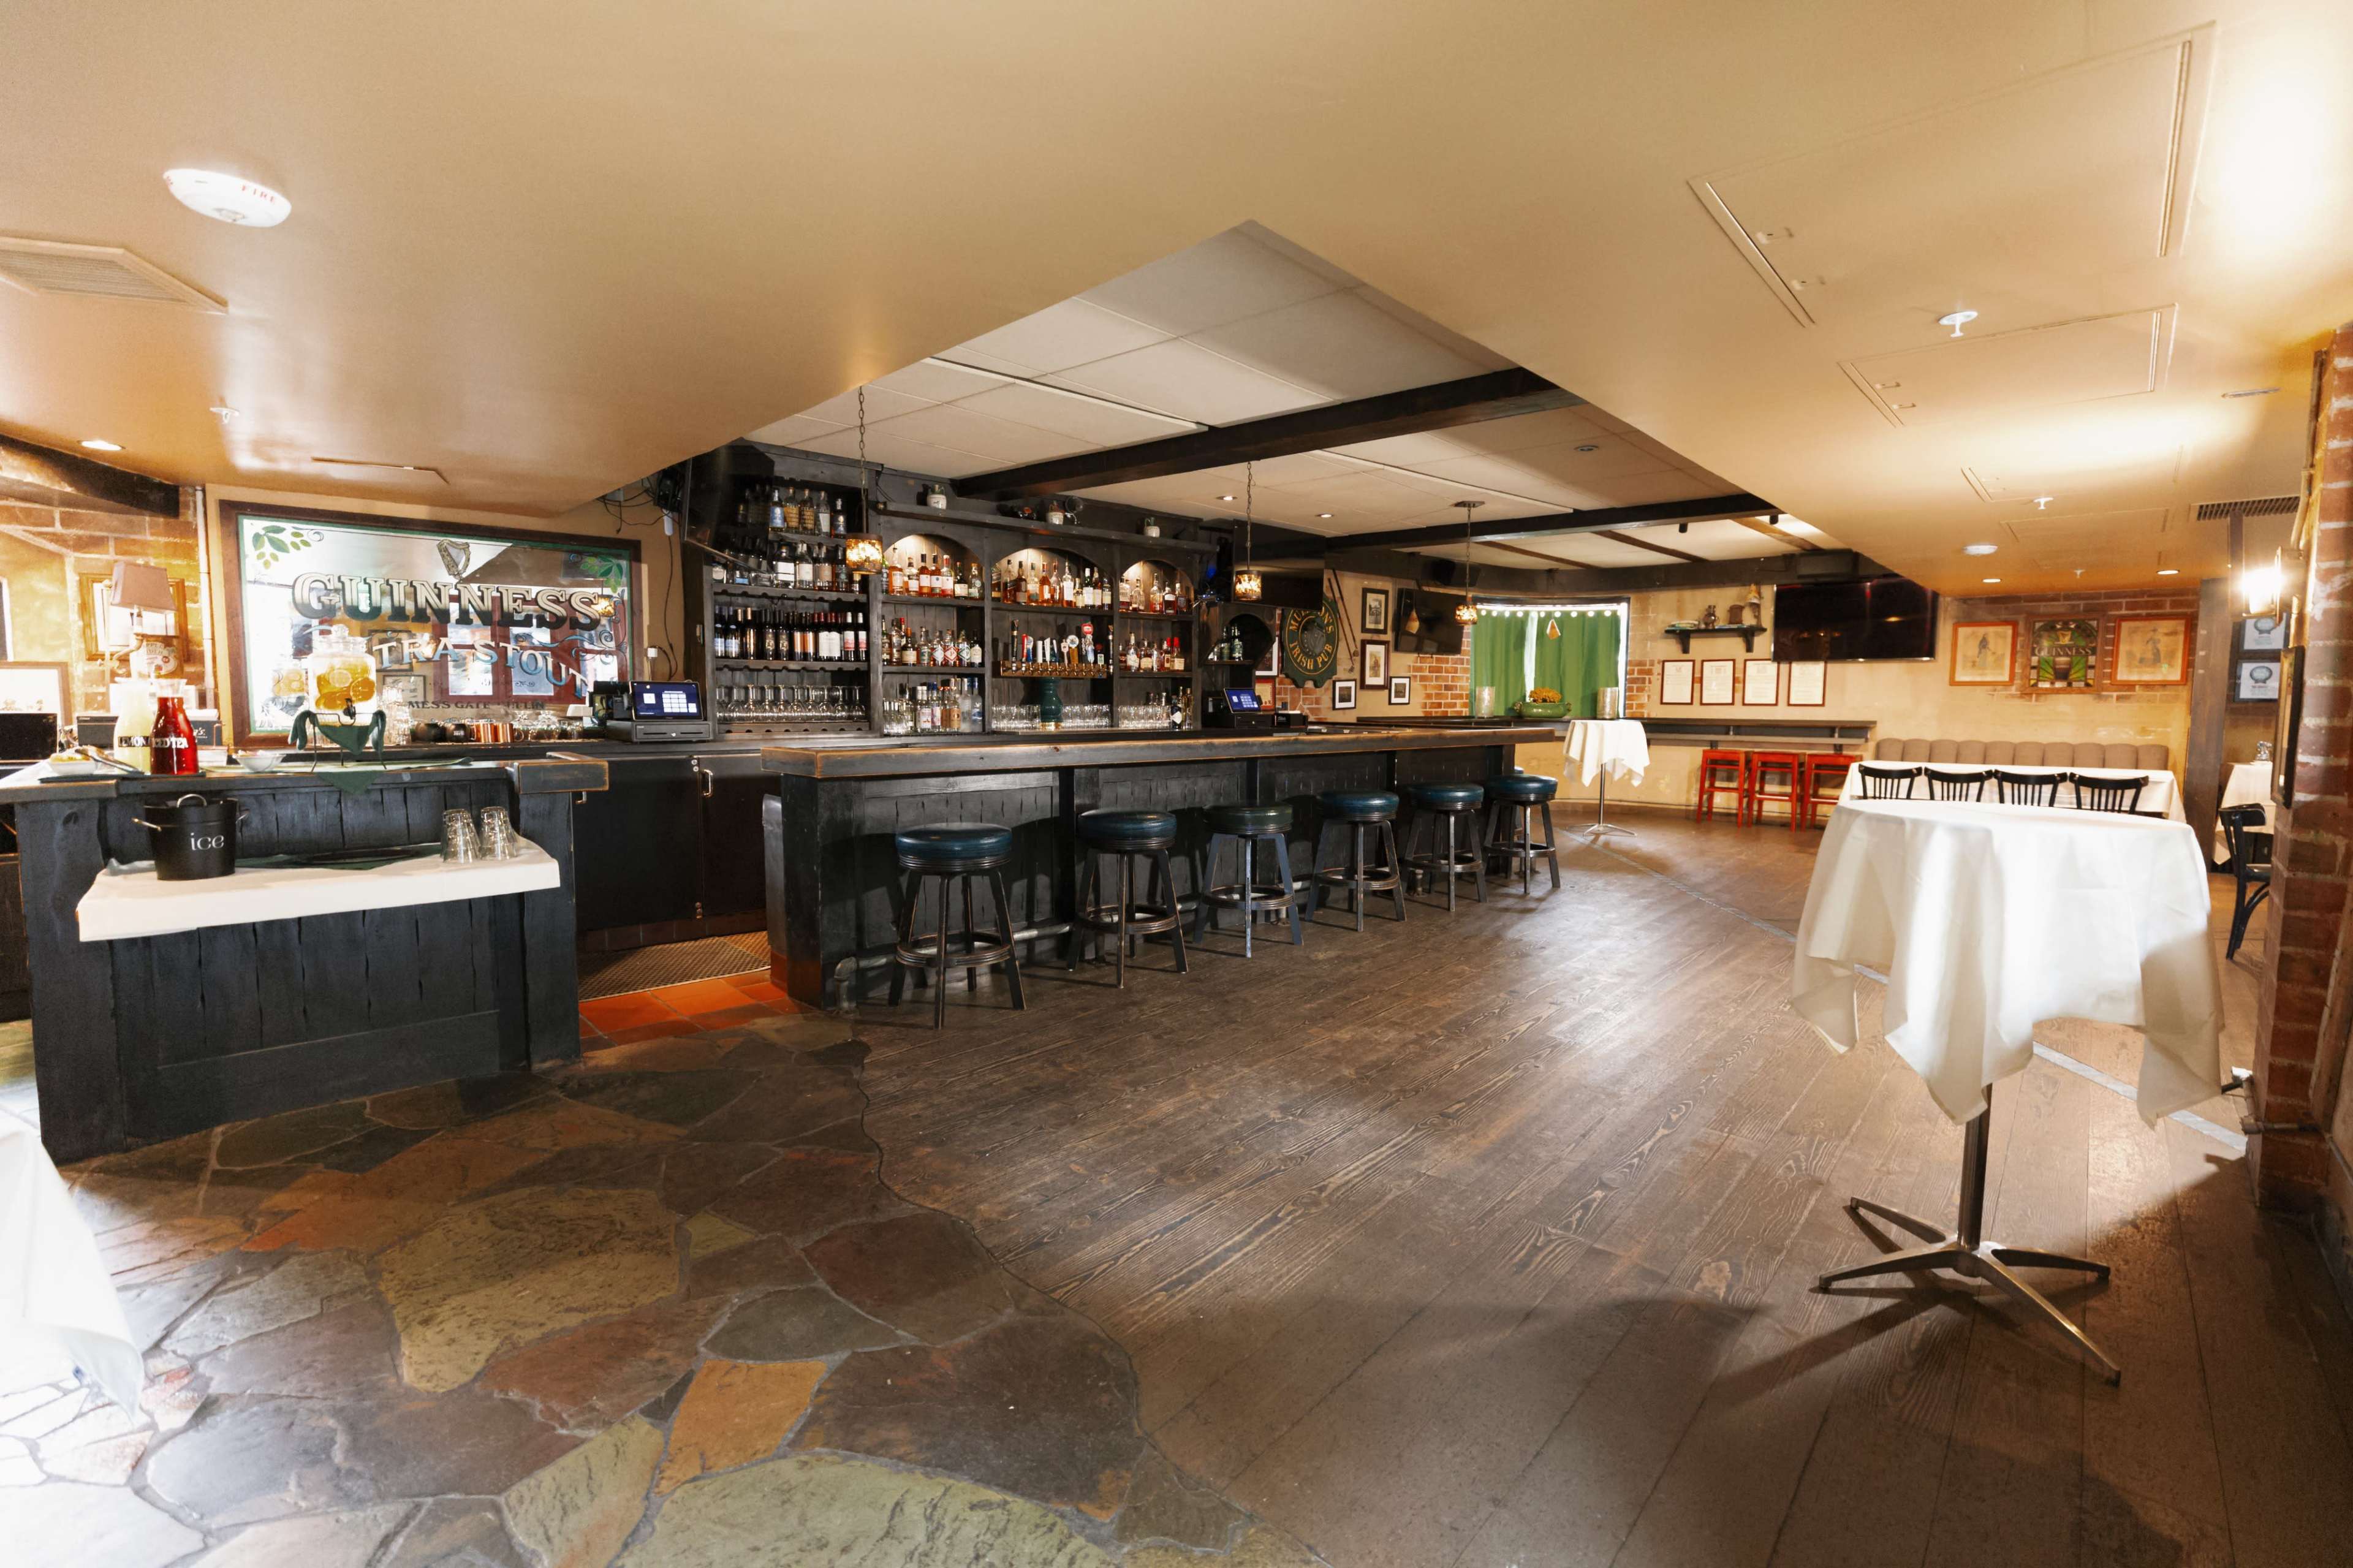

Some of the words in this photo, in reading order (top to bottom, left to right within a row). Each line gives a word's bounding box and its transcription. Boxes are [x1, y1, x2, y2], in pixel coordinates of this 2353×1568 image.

[292, 572, 602, 631] GUINNESS
[1289, 640, 1314, 670] IRISH
[1316, 643, 1333, 668] PUB
[2034, 646, 2092, 656] GUINNESS
[373, 637, 459, 668] TRA
[472, 639, 588, 700] STOUT
[118, 736, 150, 747] LEMON
[153, 737, 170, 748] ICED
[170, 737, 189, 749] TEA
[191, 832, 224, 851] ice
